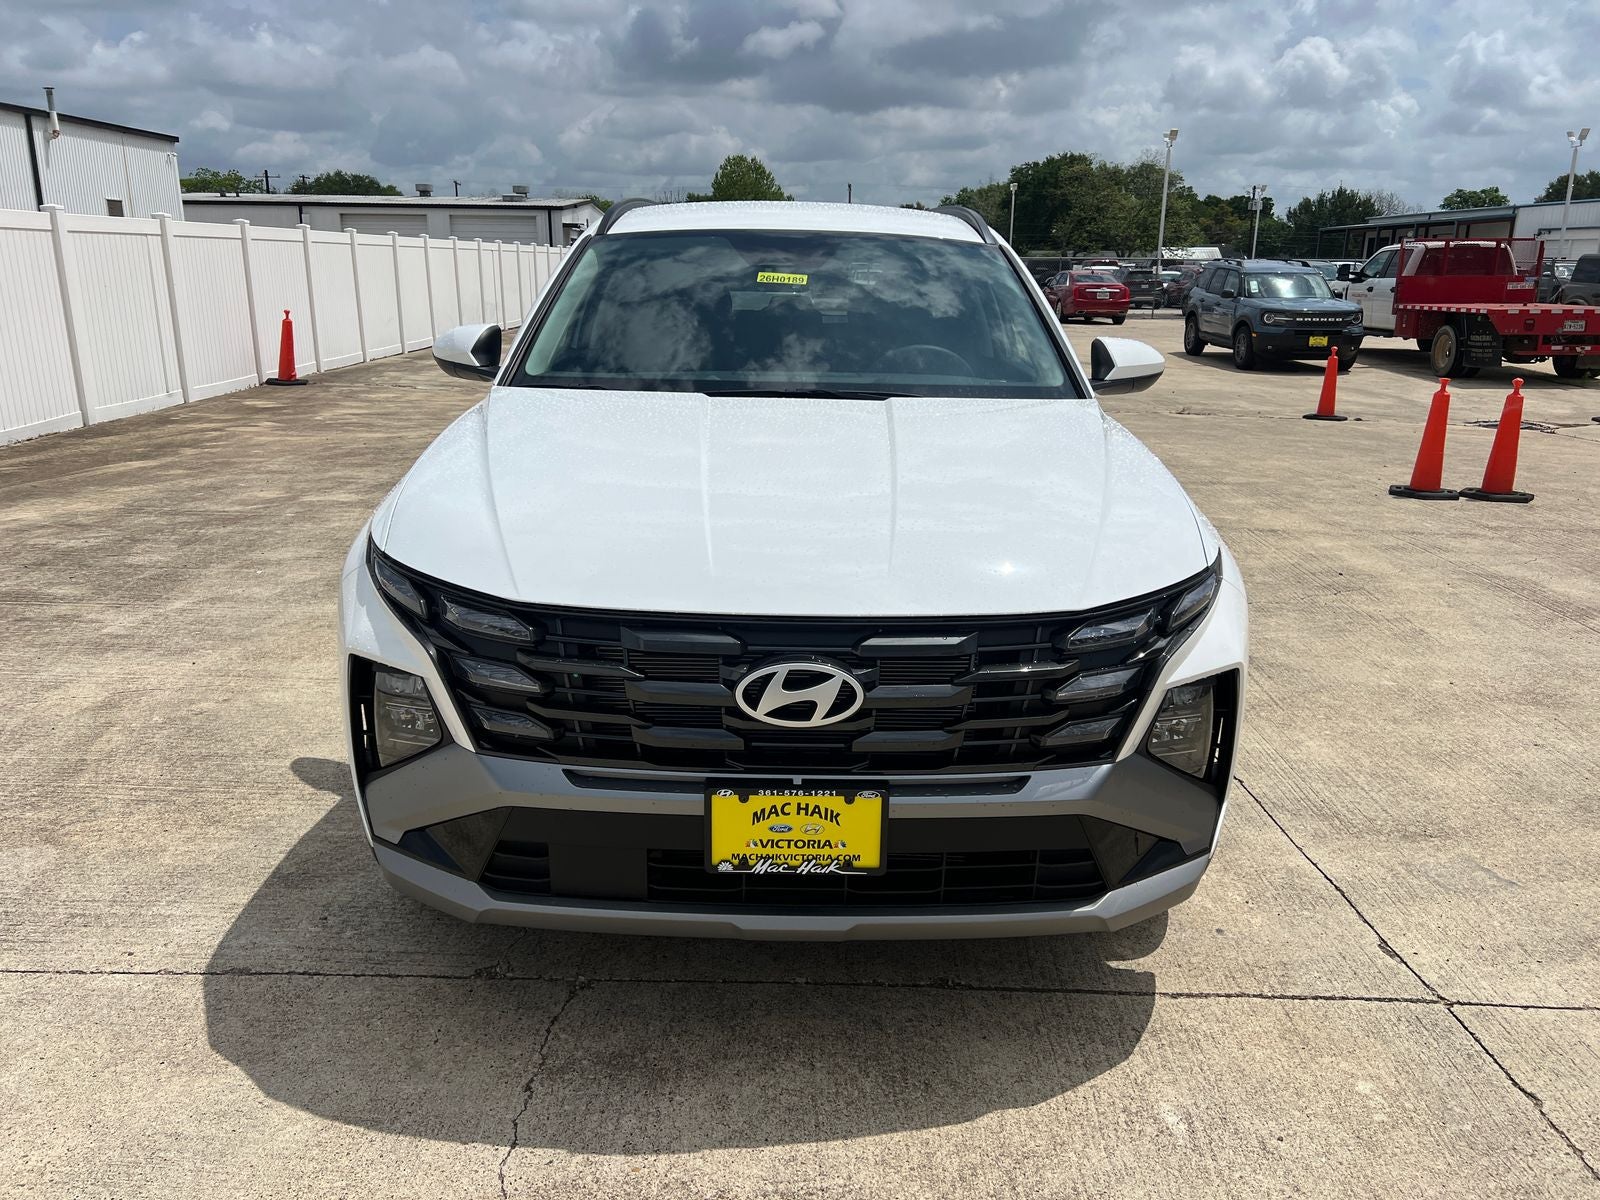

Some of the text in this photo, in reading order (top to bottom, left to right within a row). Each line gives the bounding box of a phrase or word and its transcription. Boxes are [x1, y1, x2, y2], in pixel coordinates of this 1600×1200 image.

[759, 274, 805, 283] 26H0189
[752, 802, 841, 826] MAC HAIK
[771, 824, 790, 832] Ford
[758, 839, 833, 849] VICTORIA
[731, 853, 861, 862] MACHAIKVICTORIA.COM
[751, 859, 842, 874] Mac Haik
